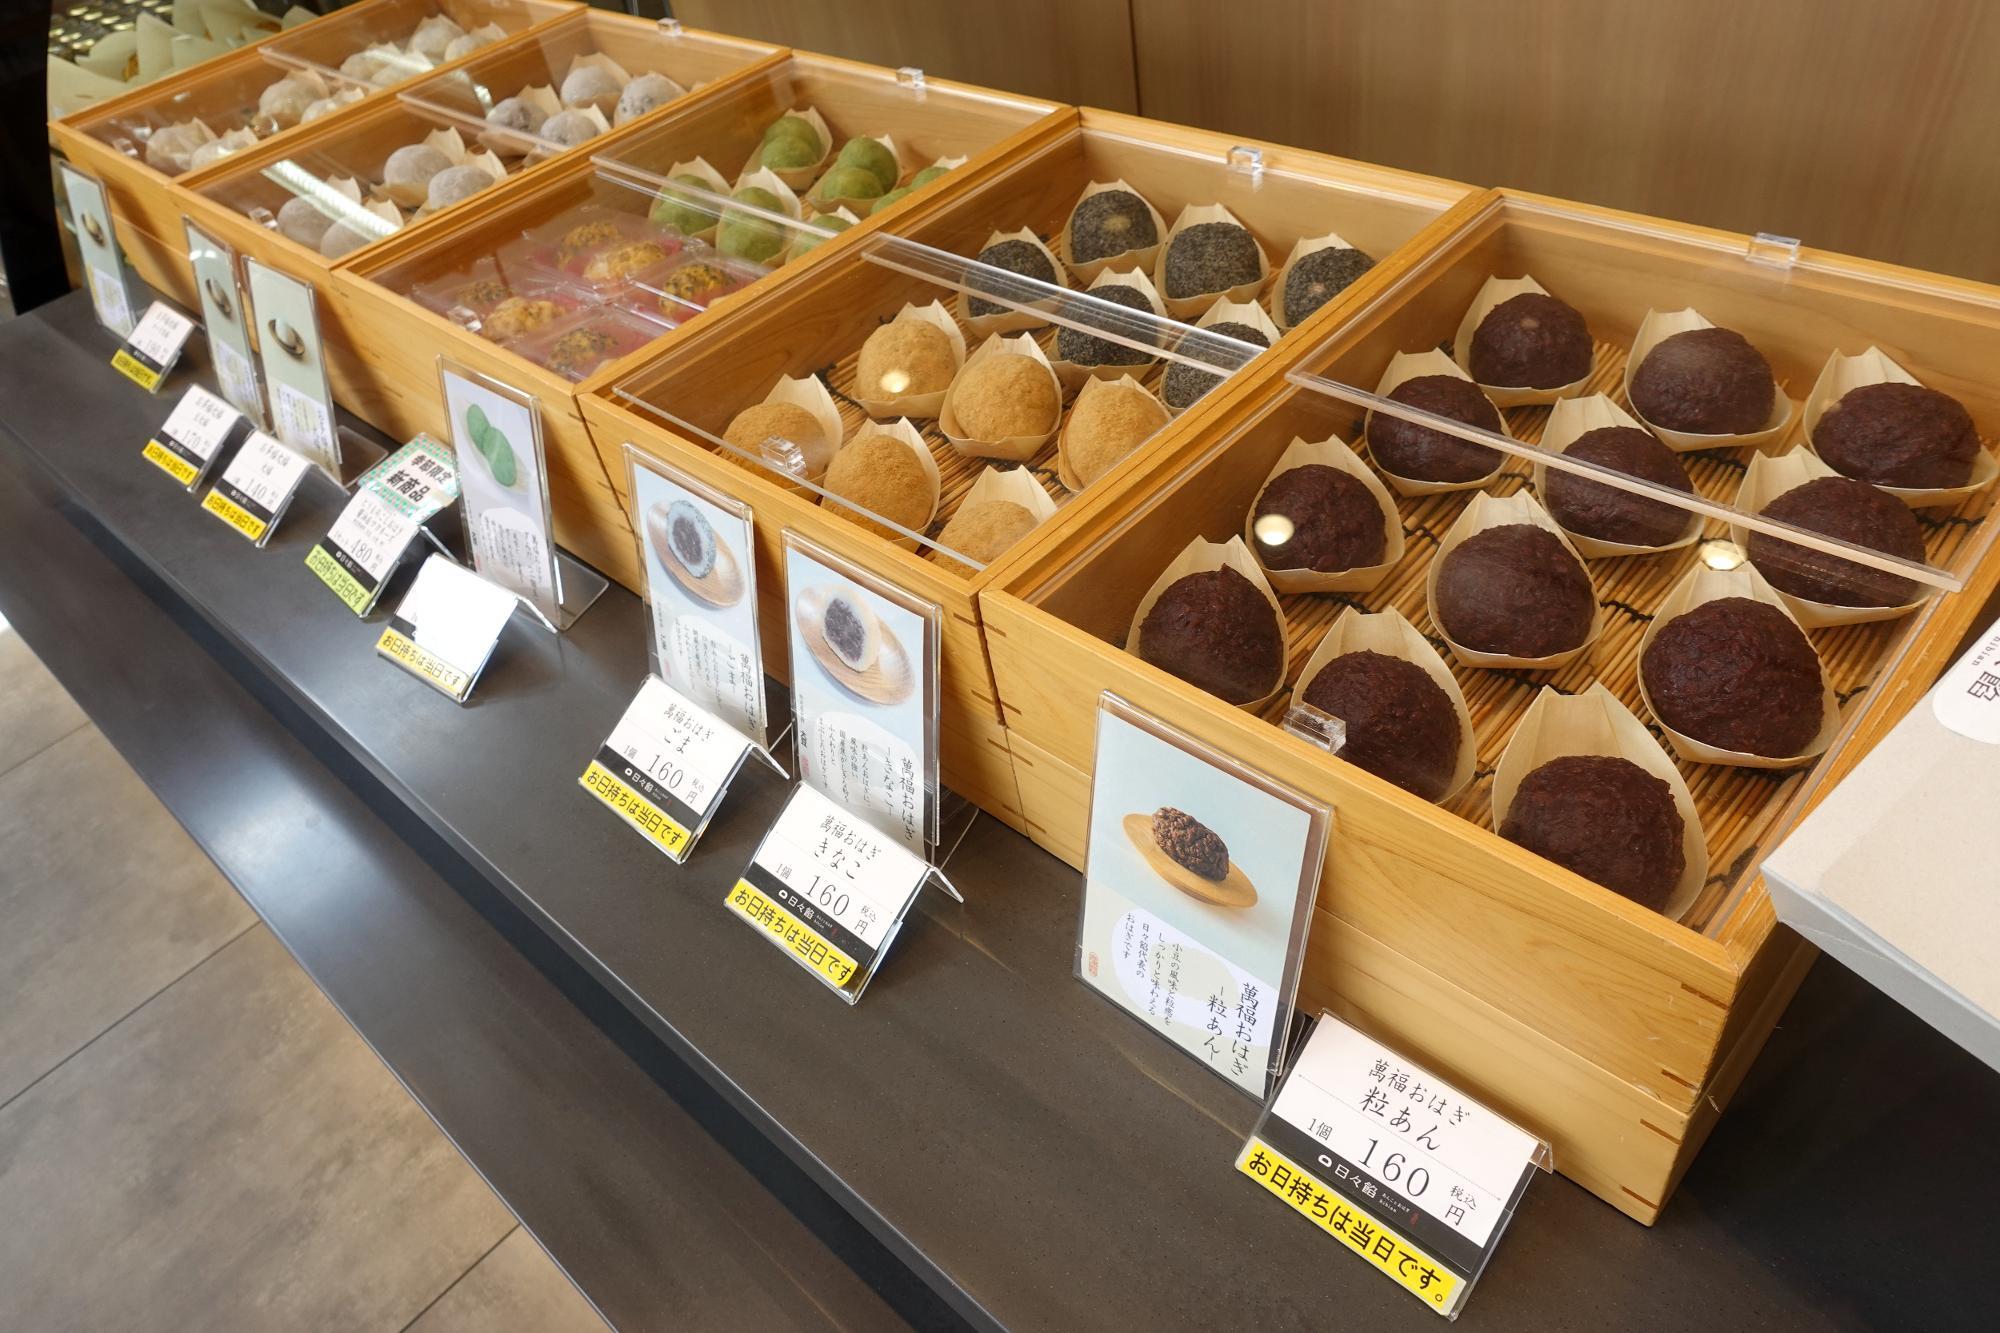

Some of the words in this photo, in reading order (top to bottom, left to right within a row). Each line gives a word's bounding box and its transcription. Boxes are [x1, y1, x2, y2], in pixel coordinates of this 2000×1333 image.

[387, 469, 431, 502] 新商品
[411, 454, 452, 484] 季節限定
[382, 634, 462, 686] お日持ちは当日です
[663, 702, 716, 743] 萬福おはぎ
[663, 727, 691, 755] ごま
[646, 754, 685, 790] 160
[686, 791, 698, 805] 円
[586, 770, 683, 847] お日持ちは当日です
[814, 837, 863, 881] きなこ
[819, 814, 882, 861] 萬福おはぎ
[775, 862, 793, 881] 1個
[803, 874, 850, 917] 160
[854, 918, 868, 936] 円
[787, 895, 815, 920] 日々餡
[860, 904, 878, 924] 税込
[734, 888, 852, 982] お日持ちは当日です
[1123, 912, 1136, 960] おはぎです
[1148, 932, 1166, 1017] しっかりと味わえる
[1231, 982, 1259, 1076] 萬福おはぎ
[1368, 1058, 1471, 1126] 萬福おはぎ
[1358, 1085, 1442, 1152] 粒あん
[1306, 1117, 1333, 1143] 1個
[1358, 1137, 1431, 1198] 160
[1444, 1205, 1466, 1227] 円
[1334, 1163, 1379, 1199] 日々餡
[1450, 1184, 1478, 1212] 税込
[1247, 1150, 1445, 1303] お日持ちは当日です。
